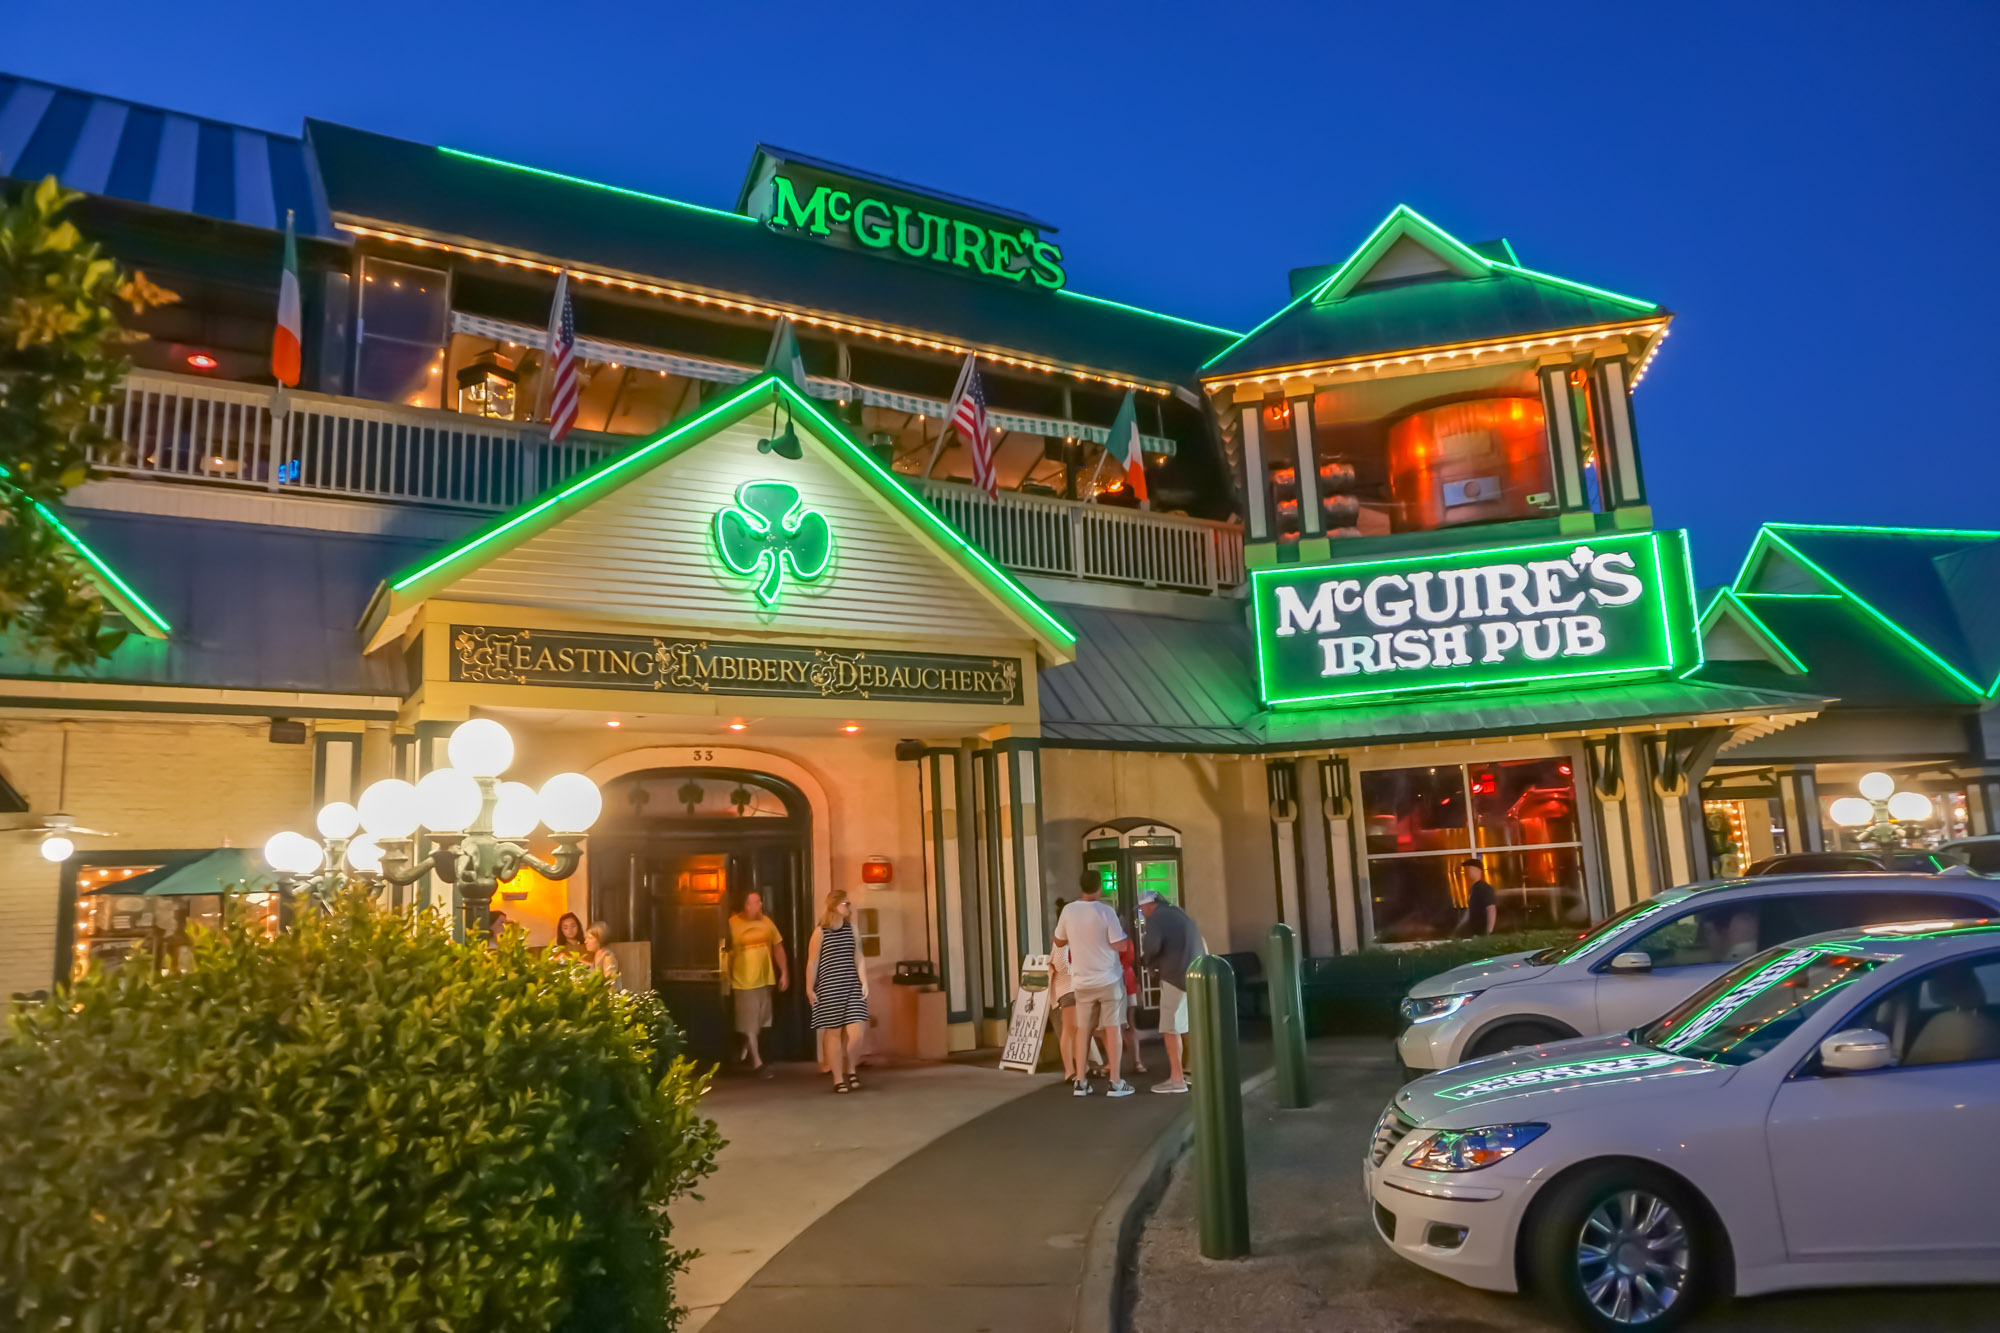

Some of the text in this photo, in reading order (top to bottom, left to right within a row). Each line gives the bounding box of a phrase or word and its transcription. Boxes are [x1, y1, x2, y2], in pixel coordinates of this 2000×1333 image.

[1318, 616, 1606, 676] IRISH PUB
[493, 640, 655, 677] FEASTING
[677, 649, 811, 683] IMBIBERY
[835, 659, 1000, 692] DEBAUCHERY
[693, 750, 713, 761] 33
[1015, 1020, 1037, 1029] WINE
[1010, 1027, 1038, 1038] CELLAR
[1010, 1042, 1032, 1052] GIFT
[1006, 1050, 1031, 1061] SHOP
